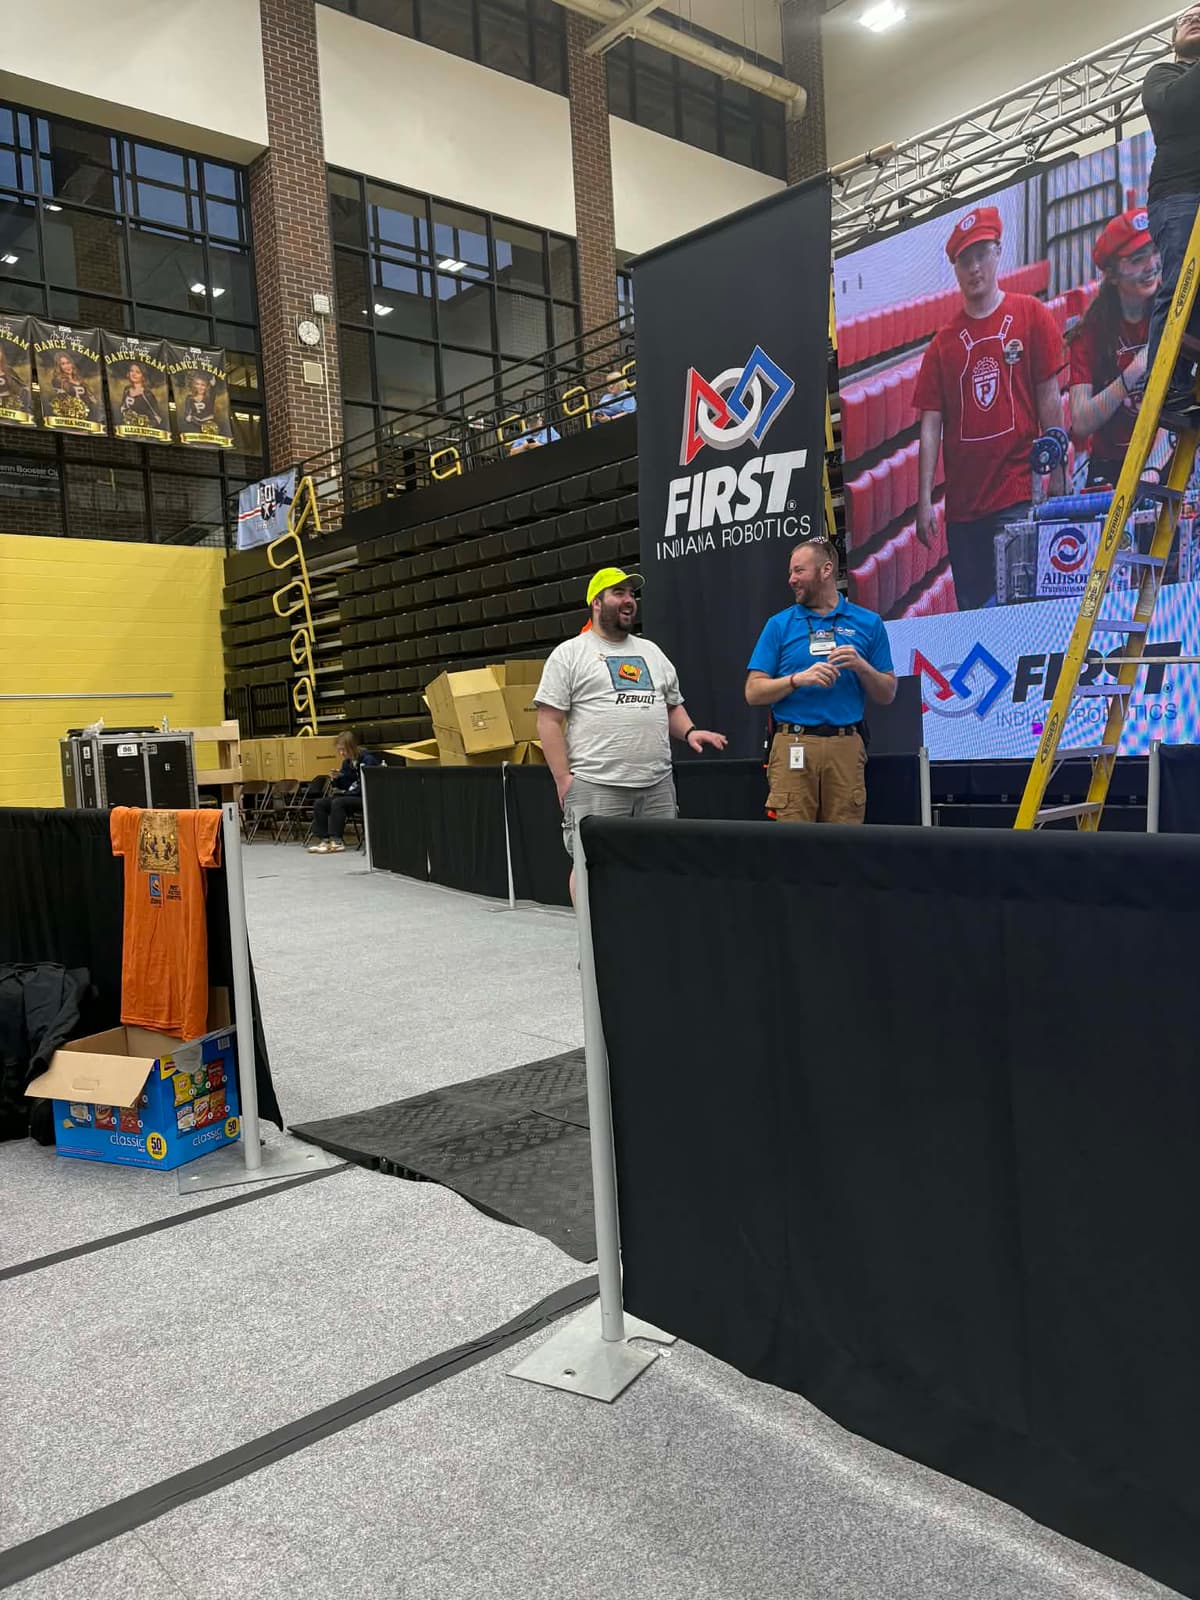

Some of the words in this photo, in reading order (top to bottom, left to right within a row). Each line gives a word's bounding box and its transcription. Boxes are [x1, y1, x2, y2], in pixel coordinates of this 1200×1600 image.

[33, 339, 67, 353] DANCE
[71, 341, 100, 362] TEAM
[104, 351, 136, 365] DANCE
[138, 352, 167, 373] TEAM
[169, 359, 199, 375] DANCE
[201, 361, 227, 380] TEAM
[664, 449, 808, 537] FIRST
[656, 531, 716, 561] INDIANA
[722, 514, 811, 549] ROBOTICS
[615, 693, 656, 705] REBUILT
[228, 1119, 237, 1132] 50
[110, 1132, 146, 1149] classic
[151, 1136, 162, 1151] 50
[193, 1127, 222, 1146] classic
